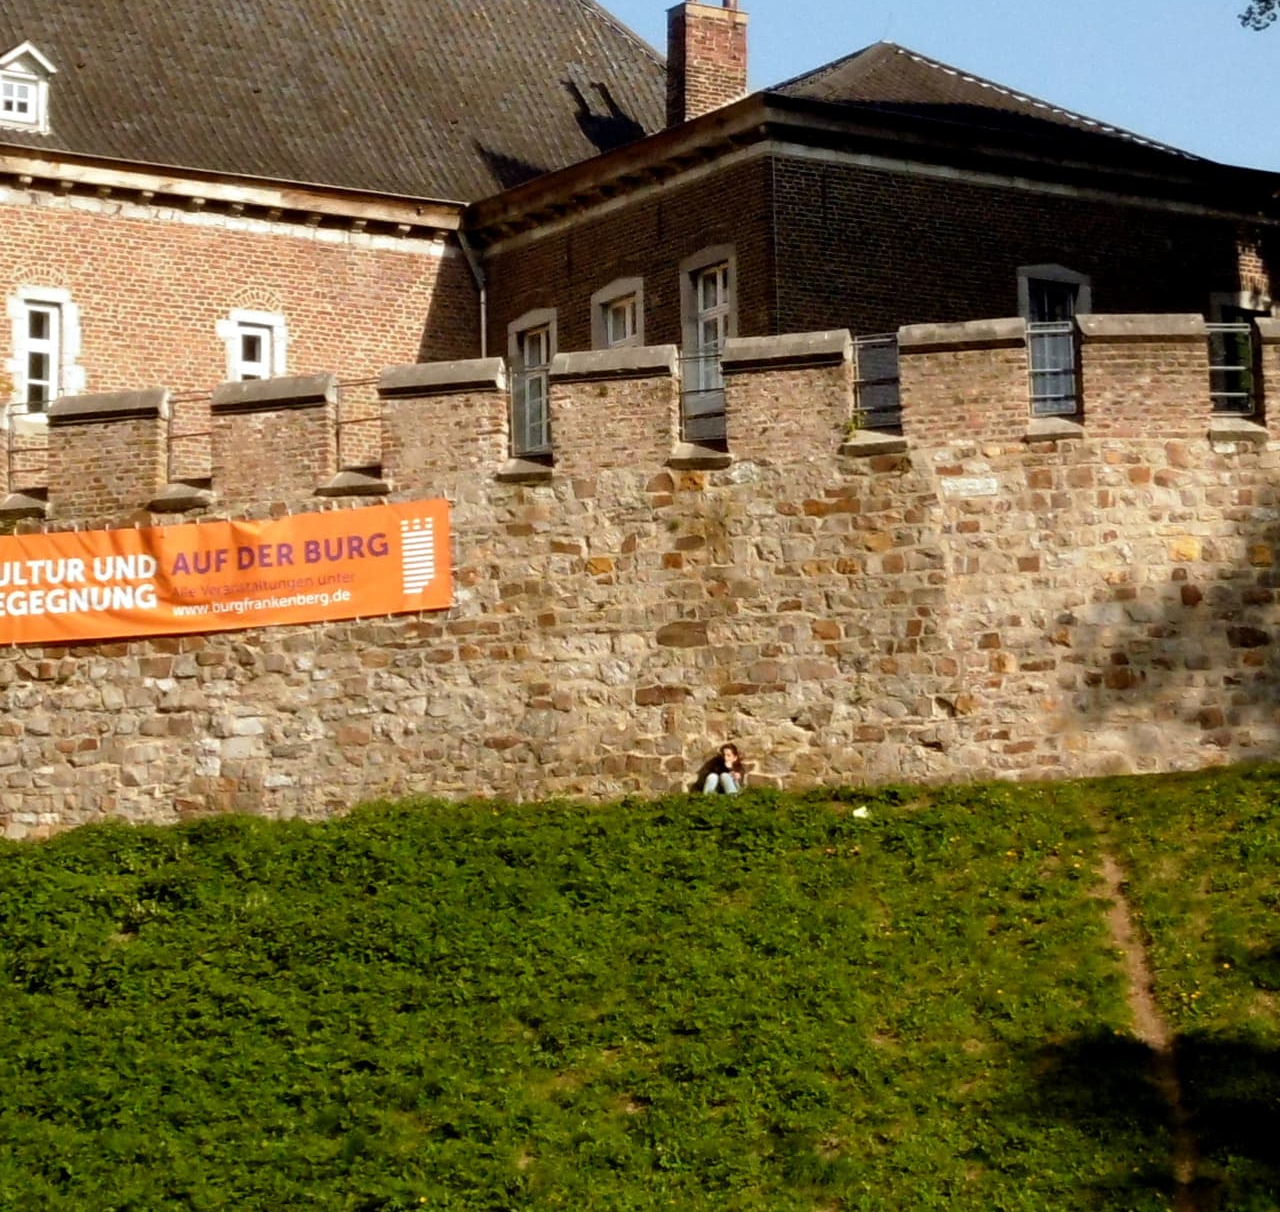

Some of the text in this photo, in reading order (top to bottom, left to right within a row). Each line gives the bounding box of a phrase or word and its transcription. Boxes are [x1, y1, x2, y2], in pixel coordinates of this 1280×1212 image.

[93, 554, 157, 581] UND
[171, 533, 389, 576] AUF DER BURG
[318, 572, 355, 585] unter
[172, 588, 351, 617] www.burgfrankenberg.de
